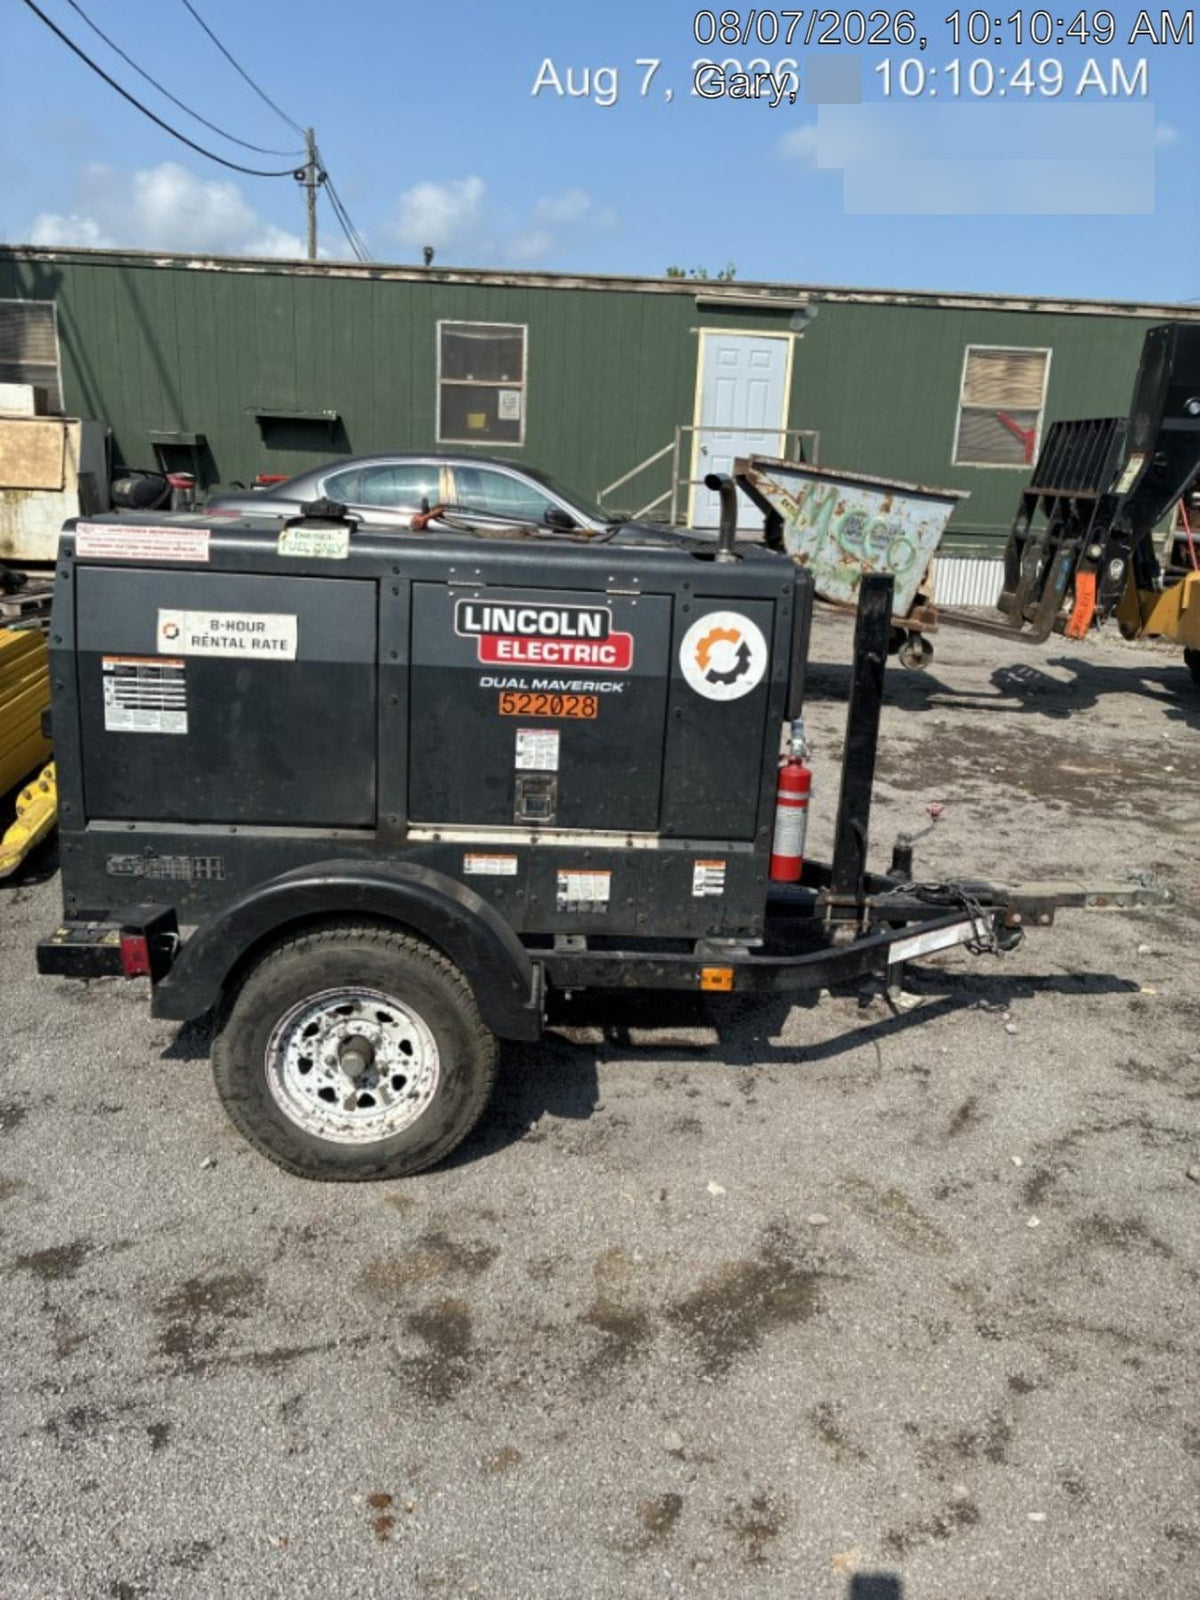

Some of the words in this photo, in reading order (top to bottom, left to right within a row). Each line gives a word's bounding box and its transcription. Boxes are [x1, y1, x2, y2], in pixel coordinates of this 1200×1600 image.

[210, 619, 266, 633] 8-HOUR
[464, 605, 602, 638] LINCOLN
[191, 634, 246, 649] RENTAL
[251, 638, 289, 651] RATE
[496, 639, 617, 664] ELECTRIC
[479, 676, 530, 690] DUAL
[531, 678, 624, 693] MAVERICK
[502, 693, 595, 717] 522028
